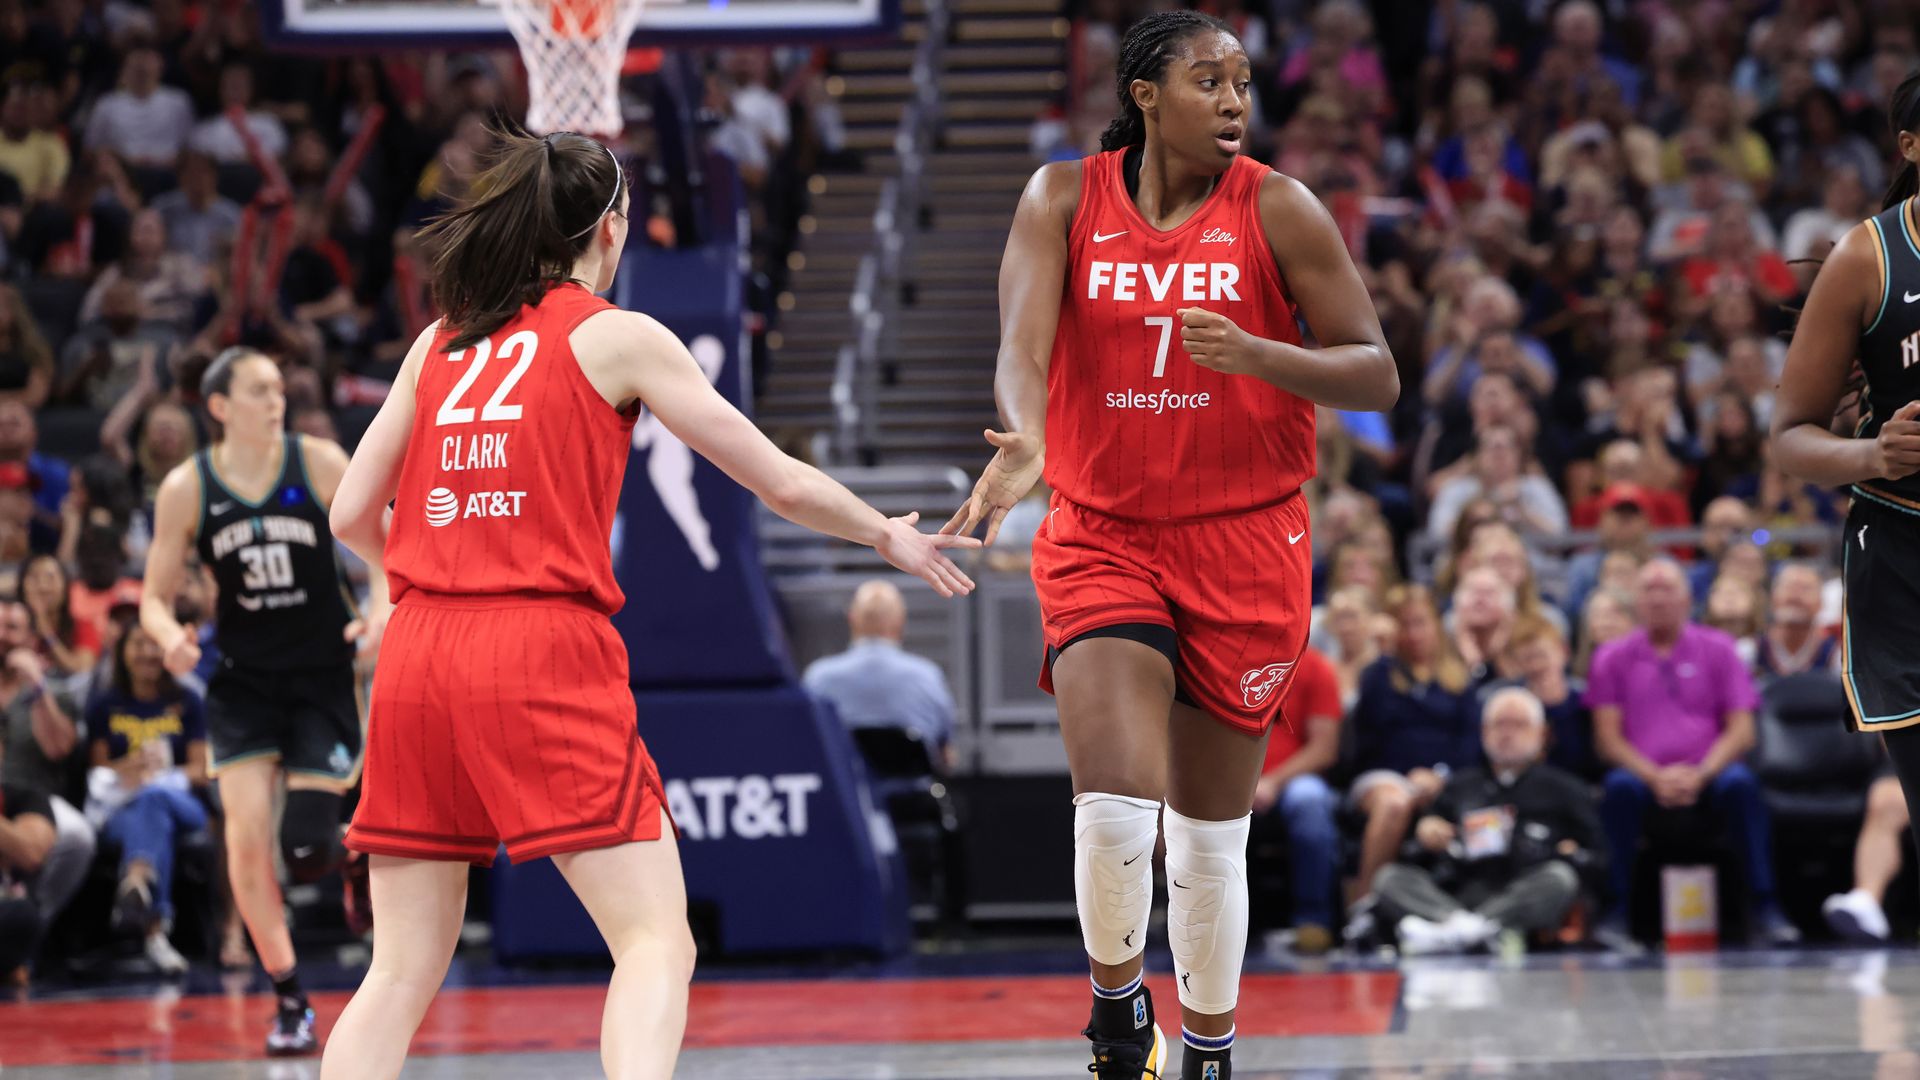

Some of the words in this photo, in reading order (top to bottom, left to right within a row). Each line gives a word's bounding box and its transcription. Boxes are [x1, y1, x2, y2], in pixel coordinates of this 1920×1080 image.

[1200, 228, 1237, 246] Lilly
[1088, 261, 1242, 302] FEVER
[1144, 316, 1173, 378] 7
[1901, 329, 1920, 370] N
[435, 330, 539, 426] 22
[1106, 388, 1210, 414] salesforce
[441, 432, 508, 472] CLARK
[463, 491, 527, 519] AT&T
[239, 543, 294, 590] 30
[665, 773, 822, 841] AT&T
